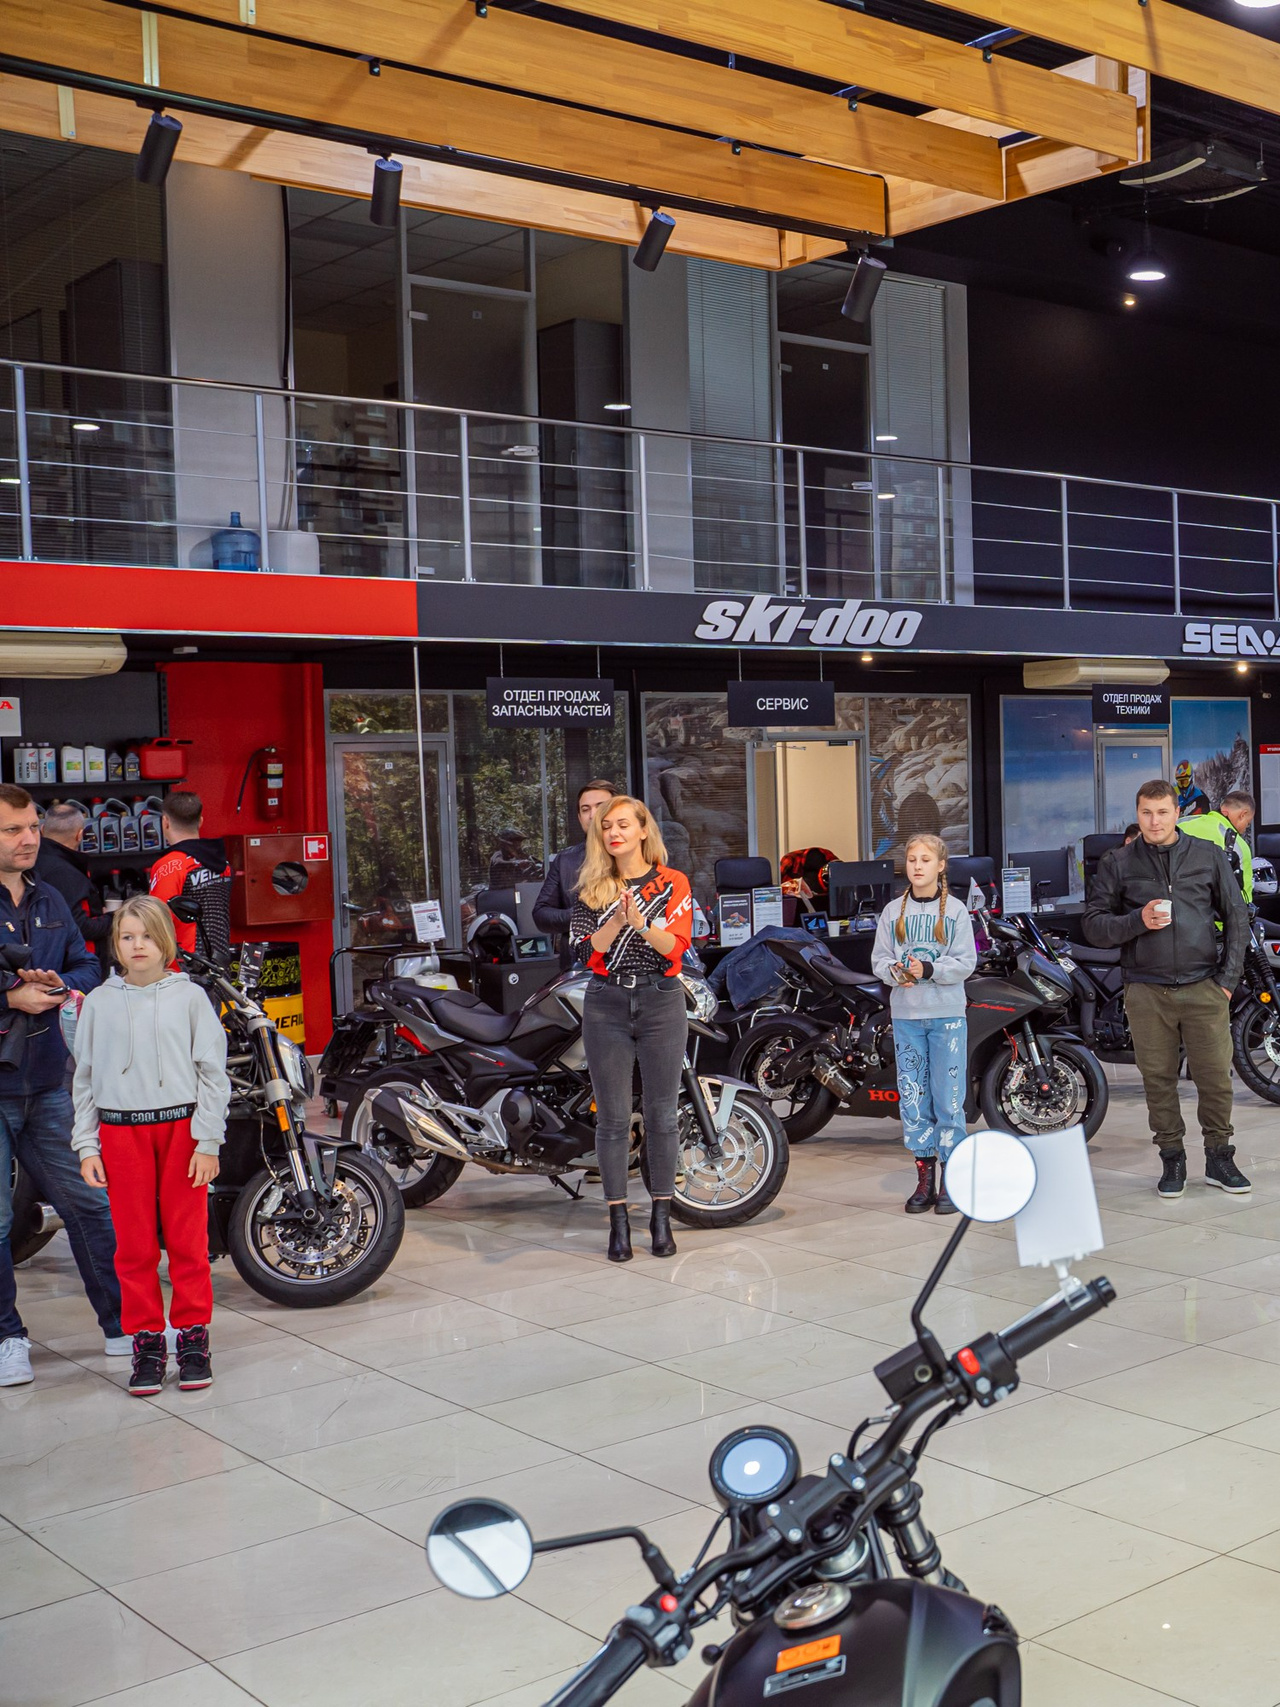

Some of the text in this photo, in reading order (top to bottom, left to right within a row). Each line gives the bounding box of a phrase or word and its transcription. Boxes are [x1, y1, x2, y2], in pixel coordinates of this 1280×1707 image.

[503, 690, 600, 703] ОТДЕЛ ПРОДАЖ
[1103, 693, 1162, 705] ОТДЕЛ ПРОДАЖ
[492, 703, 611, 717] ЗАПАСНЫХ ЧАСТЕЙ
[756, 698, 809, 710] СЕРВИС
[1116, 705, 1151, 715] ТЕХНИКИ
[131, 1111, 157, 1123] COOL
[160, 1106, 187, 1120] DOWN
[918, 1126, 934, 1144] KIND
